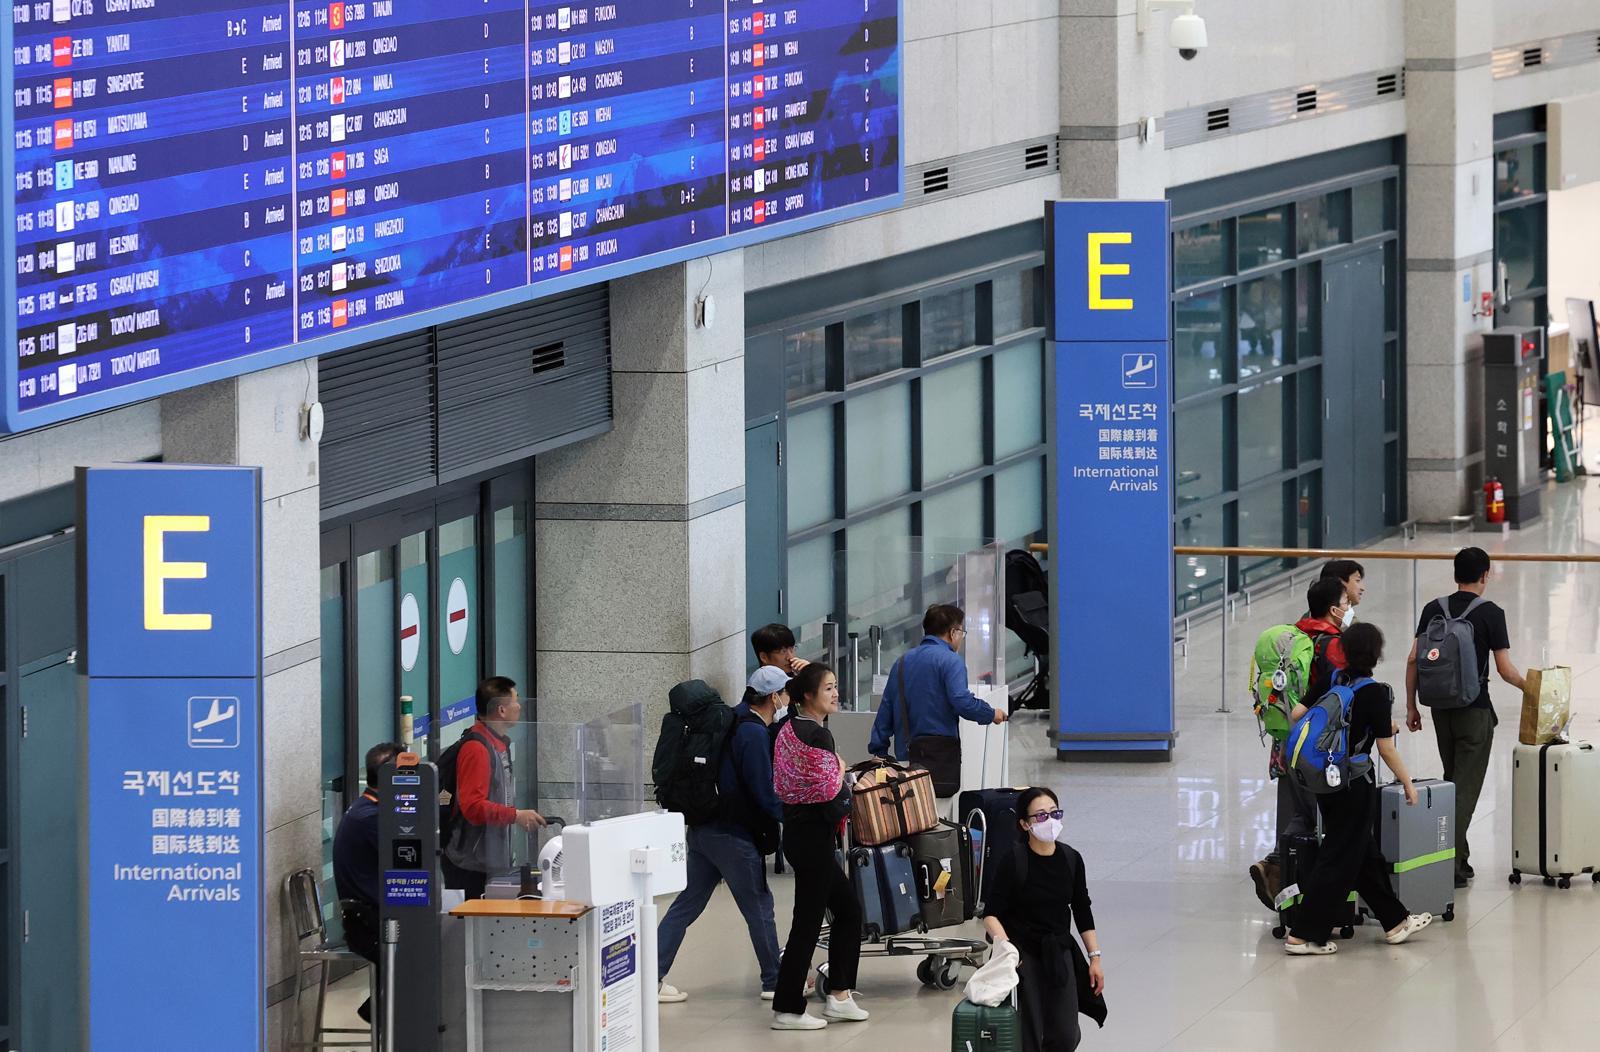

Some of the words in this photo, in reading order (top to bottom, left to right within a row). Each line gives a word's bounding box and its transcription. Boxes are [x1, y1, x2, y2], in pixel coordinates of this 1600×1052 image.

[372, 0, 392, 18] TIANJIN
[594, 4, 616, 22] FUKUOKA
[864, 0, 869, 12] B
[72, 40, 82, 58] ZE
[106, 34, 130, 52] YANTAI
[262, 14, 282, 32] Arrived
[372, 36, 398, 54] QINGDAO
[483, 22, 489, 38] D
[594, 38, 614, 56] NAGOYA
[689, 26, 694, 40] B
[106, 72, 144, 94] SINGAPORE
[241, 58, 248, 74] E
[262, 52, 282, 70] Arrived
[374, 74, 394, 92] MANILA
[484, 58, 489, 74] E
[594, 70, 622, 90] CHONGQING
[689, 58, 694, 72] E
[784, 70, 804, 88] FUKUOKA
[864, 58, 869, 72] C
[108, 112, 148, 134] MATSUYAMA
[242, 96, 248, 112] E
[264, 90, 284, 110] Arrived
[374, 108, 406, 128] CHANGCHUN
[484, 94, 490, 108] D
[690, 90, 695, 106] D
[784, 100, 808, 118] FRANKFURT
[864, 88, 870, 102] C
[374, 148, 390, 166] SAGA
[484, 128, 490, 144] C
[596, 138, 616, 158] QINGDAO
[690, 124, 695, 138] D
[784, 132, 800, 150] OSAKA/
[800, 130, 814, 146] KANSAI
[864, 118, 870, 132] C
[74, 162, 84, 180] KE
[108, 154, 136, 174] NANJING
[242, 134, 249, 152] D
[264, 128, 284, 148] Arrived
[784, 165, 796, 180] HONG
[796, 162, 808, 177] KONG
[864, 148, 869, 162] E
[374, 182, 398, 202] QINGDAO
[485, 164, 490, 180] B
[596, 174, 612, 190] MACAU
[690, 156, 695, 170] E
[108, 192, 140, 216] QINGDAO
[243, 172, 250, 190] E
[264, 166, 284, 186] Arrived
[784, 194, 804, 212] SAPPORO
[110, 234, 138, 256] HELSINKI
[243, 212, 250, 228] B
[264, 204, 284, 224] Arrived
[374, 218, 404, 238] HANGZHOU
[485, 198, 490, 214] E
[596, 204, 624, 224] CHANGCHUN
[374, 254, 402, 274] SHIZUOKA
[485, 234, 491, 250] E
[596, 238, 618, 256] FUKUOKA
[691, 220, 696, 234] B
[110, 274, 136, 296] OSAKA/
[136, 270, 160, 292] KANSAI
[244, 250, 251, 266] C
[1088, 232, 1133, 310] E
[374, 290, 404, 310] HIROSHIMA
[485, 268, 491, 284] D
[110, 314, 136, 336] TOKYO/
[136, 309, 160, 331] NARITA
[244, 288, 251, 306] C
[266, 280, 286, 300] Arrived
[110, 354, 136, 376] TOKYO/
[136, 349, 160, 369] NARITA
[244, 326, 251, 344] B
[1079, 404, 1158, 420] 국제선도착
[1098, 428, 1158, 442] 国際線到着
[1099, 447, 1158, 460] 国际线到达
[1074, 466, 1158, 478] International
[1109, 480, 1158, 492] Arrivals
[144, 516, 212, 630] E
[123, 770, 240, 796] 국제선도착
[152, 808, 240, 828] 国際線到着
[152, 835, 240, 854] 国际线到达
[114, 862, 241, 880] International
[167, 884, 240, 901] Arrivals
